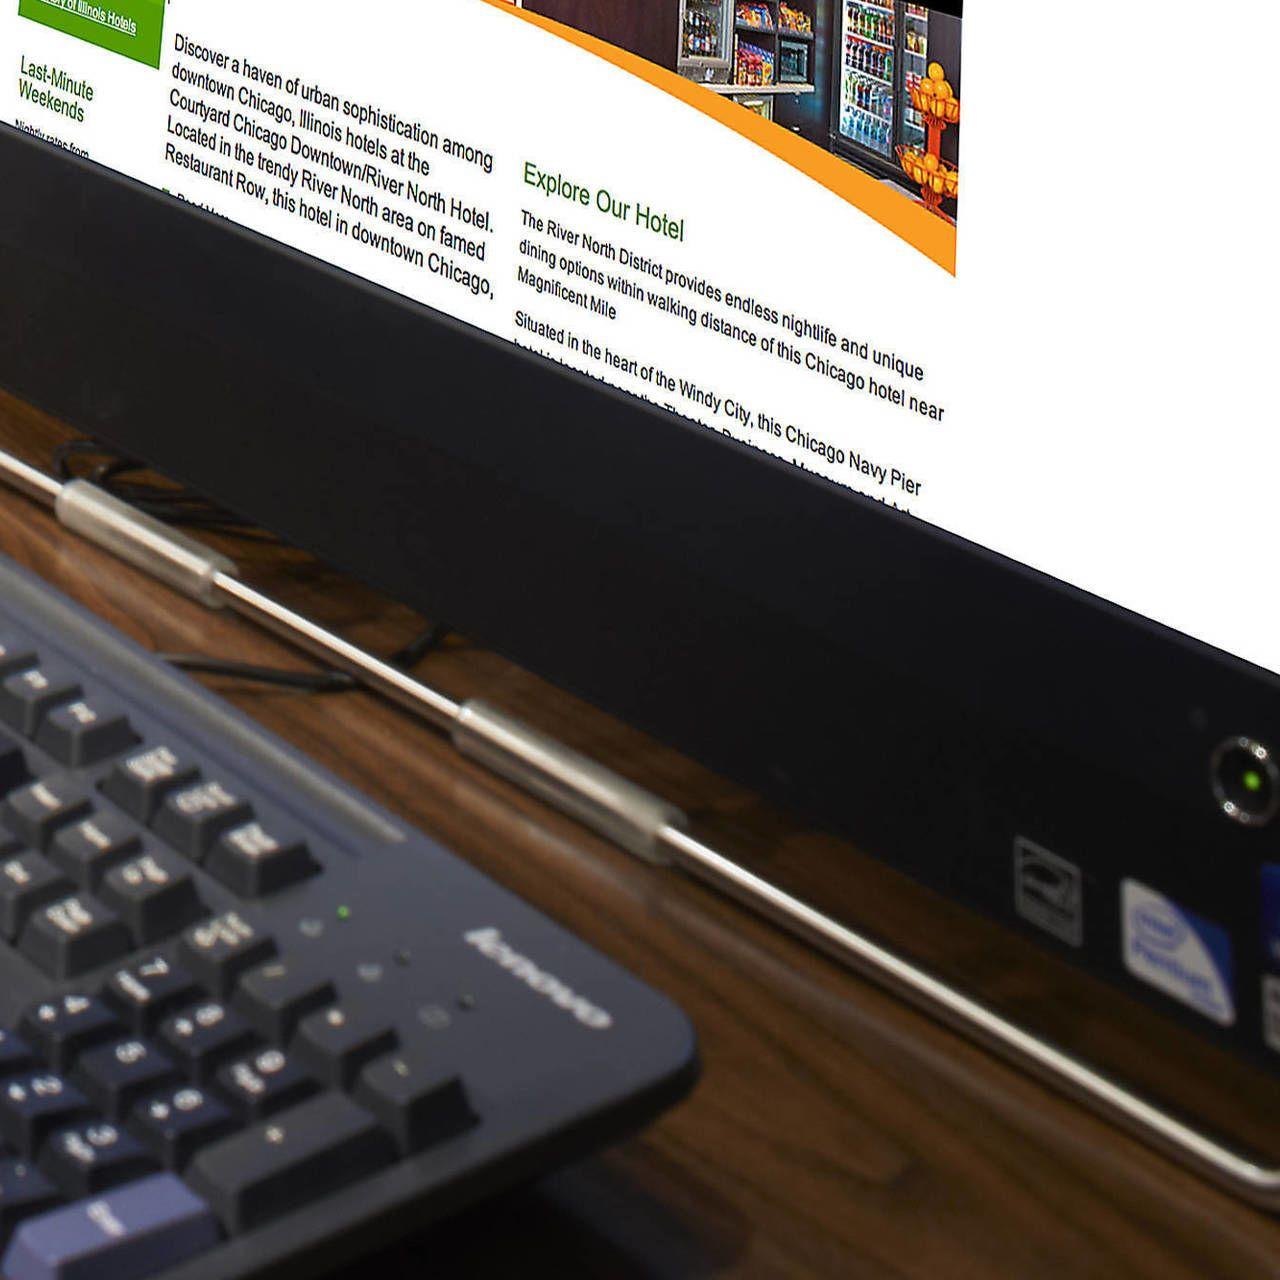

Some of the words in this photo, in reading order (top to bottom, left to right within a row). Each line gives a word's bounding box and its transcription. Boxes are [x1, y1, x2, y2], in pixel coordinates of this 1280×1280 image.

[77, 0, 105, 21] Illinois
[107, 11, 135, 32] Hotels
[19, 78, 83, 121] Weekends
[20, 56, 93, 100] Last-Minute
[172, 62, 234, 99] downtown
[238, 86, 294, 126] Chicago,
[299, 109, 341, 141] Illinois
[346, 127, 386, 159] hotels
[390, 148, 404, 166] at
[407, 151, 429, 175] the
[174, 33, 229, 68] Discover
[231, 58, 239, 73] a
[242, 58, 282, 89] haven
[285, 77, 299, 95] of
[301, 85, 338, 111] urban
[343, 101, 437, 147] sophistication
[442, 138, 492, 173] among
[169, 88, 230, 126] Courtyard
[233, 113, 286, 150] Chicago
[291, 135, 403, 194] Downtown/River
[407, 181, 445, 213] North
[450, 198, 492, 232] Hotel.
[524, 162, 589, 205] Explore
[596, 189, 630, 220] Our
[636, 203, 683, 241] Hotel
[165, 142, 232, 186] Restaurant
[235, 171, 268, 204] Row,
[272, 187, 295, 212] this
[299, 198, 331, 227] hotel
[335, 213, 347, 235] in
[351, 222, 423, 266] downtown
[428, 253, 493, 299] Chicago,
[517, 266, 587, 308] Magnificent
[590, 295, 616, 319] Mile
[521, 209, 543, 231] The
[547, 219, 579, 245] River
[582, 233, 615, 260] North
[619, 248, 662, 278] District
[665, 269, 721, 301] provides
[725, 293, 778, 323] endless
[782, 314, 836, 346] nightlife
[840, 338, 867, 359] and
[872, 350, 923, 380] unique
[515, 310, 564, 343] Situated
[567, 331, 578, 350] in
[582, 339, 600, 359] the
[605, 348, 637, 376] heart
[640, 366, 654, 381] of
[655, 370, 675, 391] the
[679, 379, 721, 413] Windy
[724, 399, 753, 427] City,
[757, 413, 781, 437] this
[785, 425, 844, 463] Chicago
[849, 451, 886, 484] Navy
[890, 468, 921, 495] Pier
